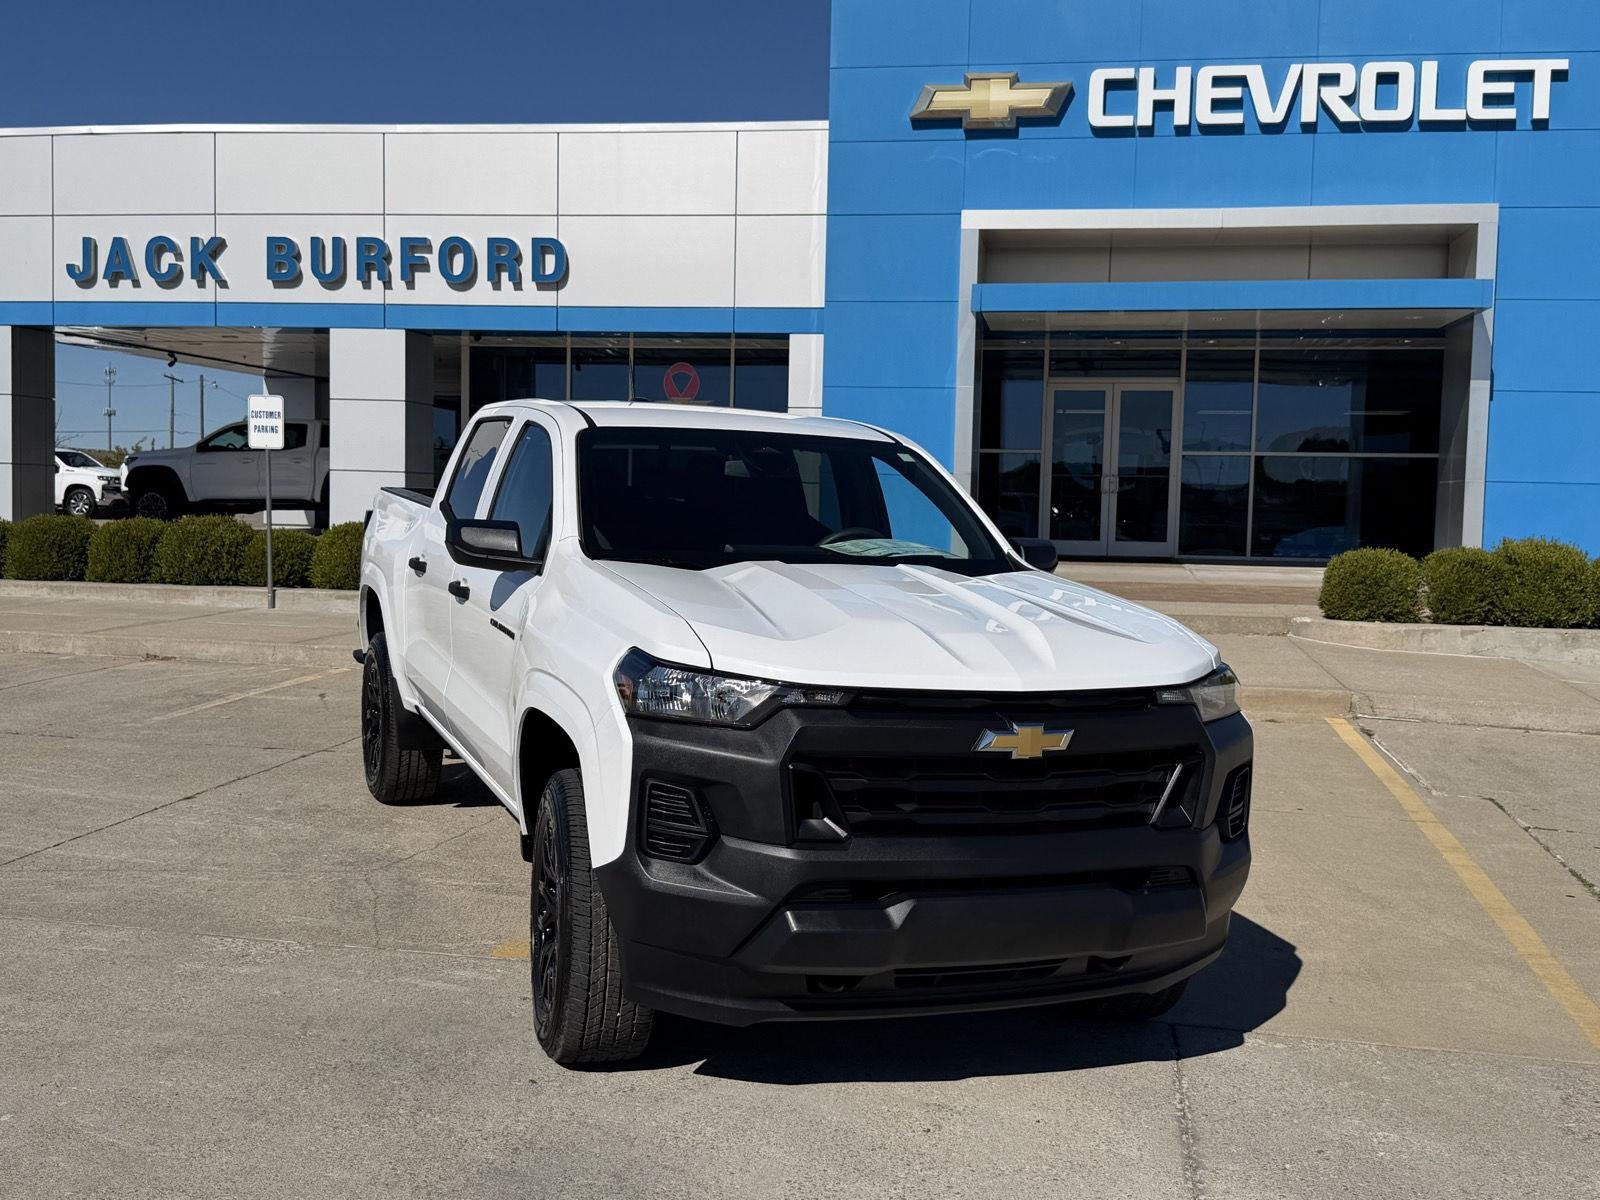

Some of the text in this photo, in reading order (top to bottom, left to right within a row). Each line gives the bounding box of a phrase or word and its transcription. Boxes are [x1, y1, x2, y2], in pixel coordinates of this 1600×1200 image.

[1088, 58, 1570, 128] CHEVROLET
[66, 235, 567, 287] JACK BURFORD
[250, 409, 282, 420] CUSTOMER
[253, 423, 279, 434] PARKING
